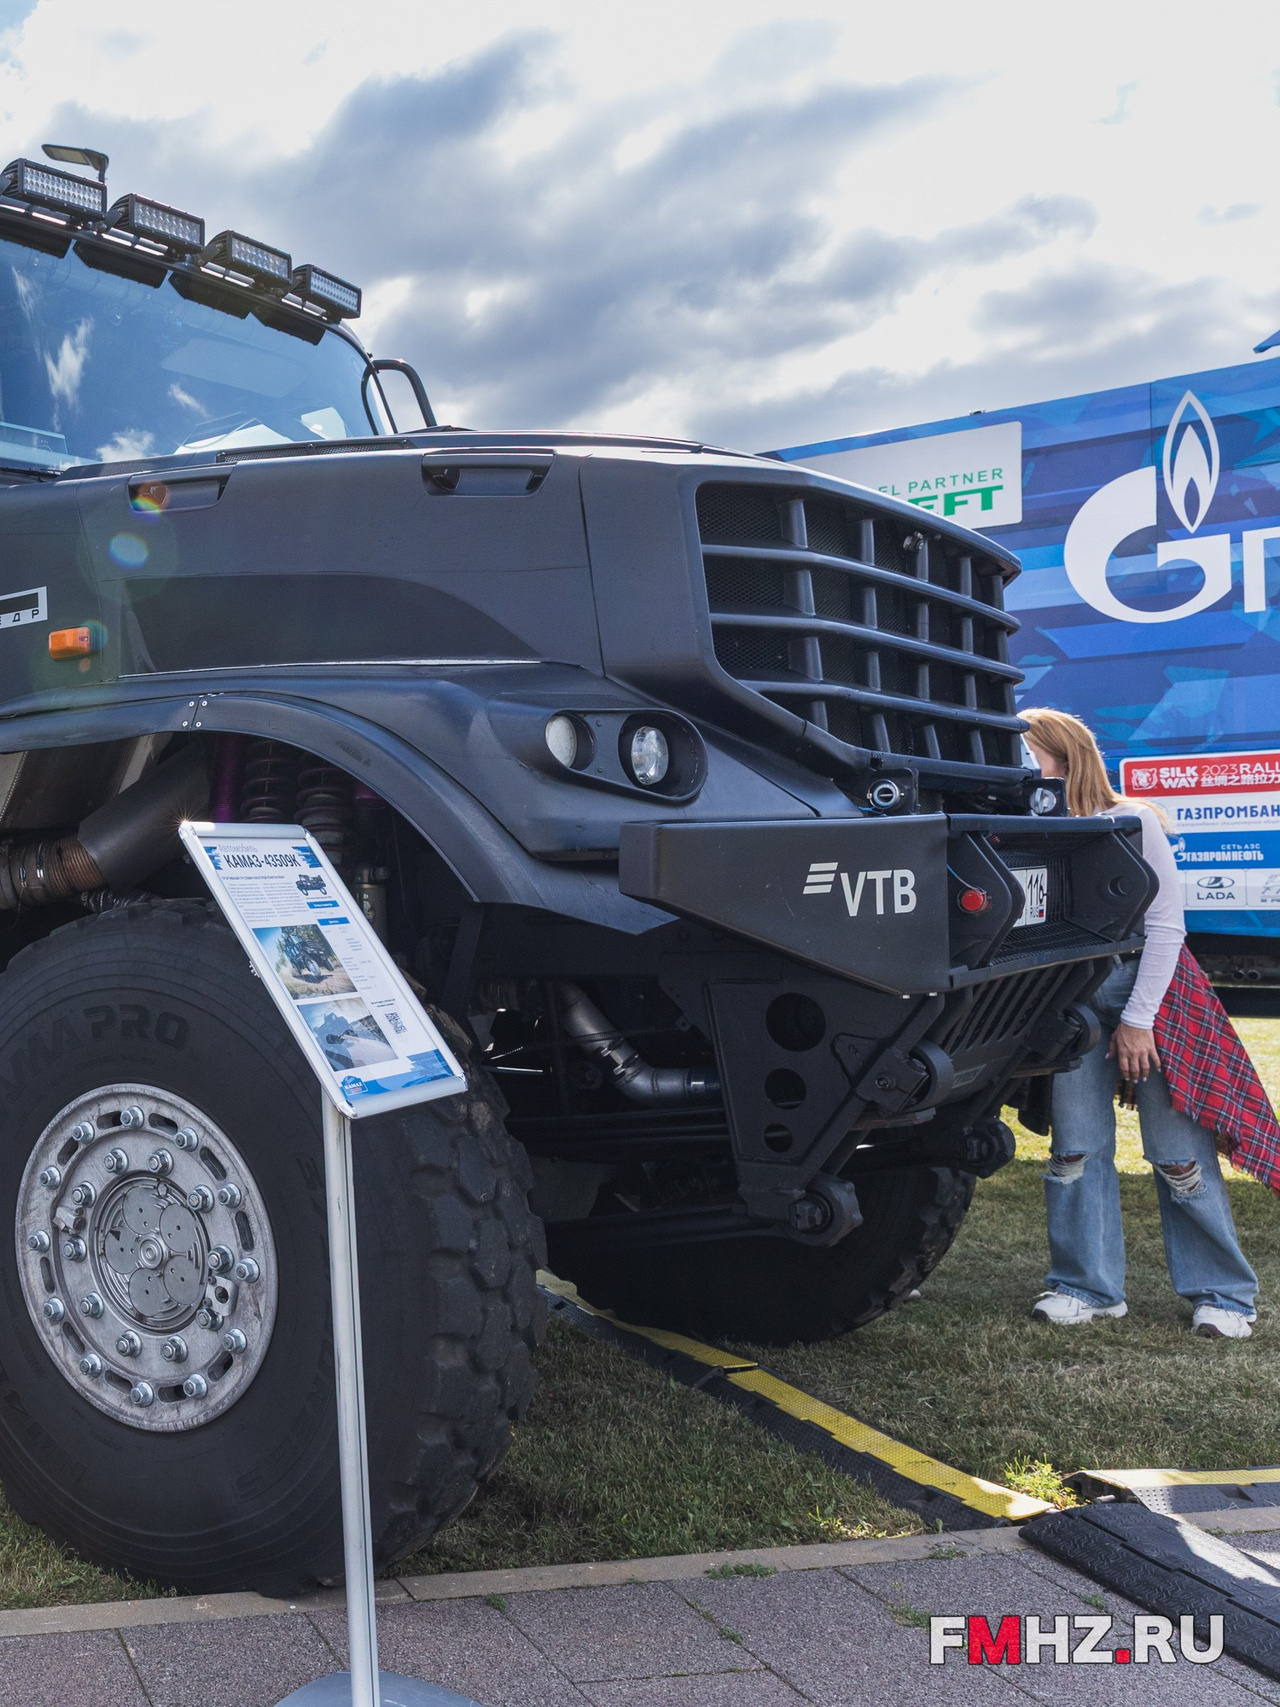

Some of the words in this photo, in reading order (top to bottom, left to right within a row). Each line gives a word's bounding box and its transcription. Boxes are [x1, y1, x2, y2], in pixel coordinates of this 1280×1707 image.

[908, 467, 1003, 493] PARTNER
[1159, 766, 1198, 778] SILK
[1201, 764, 1238, 776] 2023
[1160, 777, 1199, 789] WAY
[223, 854, 301, 868] КАМАЗ-43509К
[1186, 851, 1264, 862] ГАЗПРОМНЕФТЬ
[840, 869, 917, 917] VTB
[1027, 873, 1044, 905] 116
[1197, 891, 1236, 900] LADA
[82, 1003, 189, 1051] PRO
